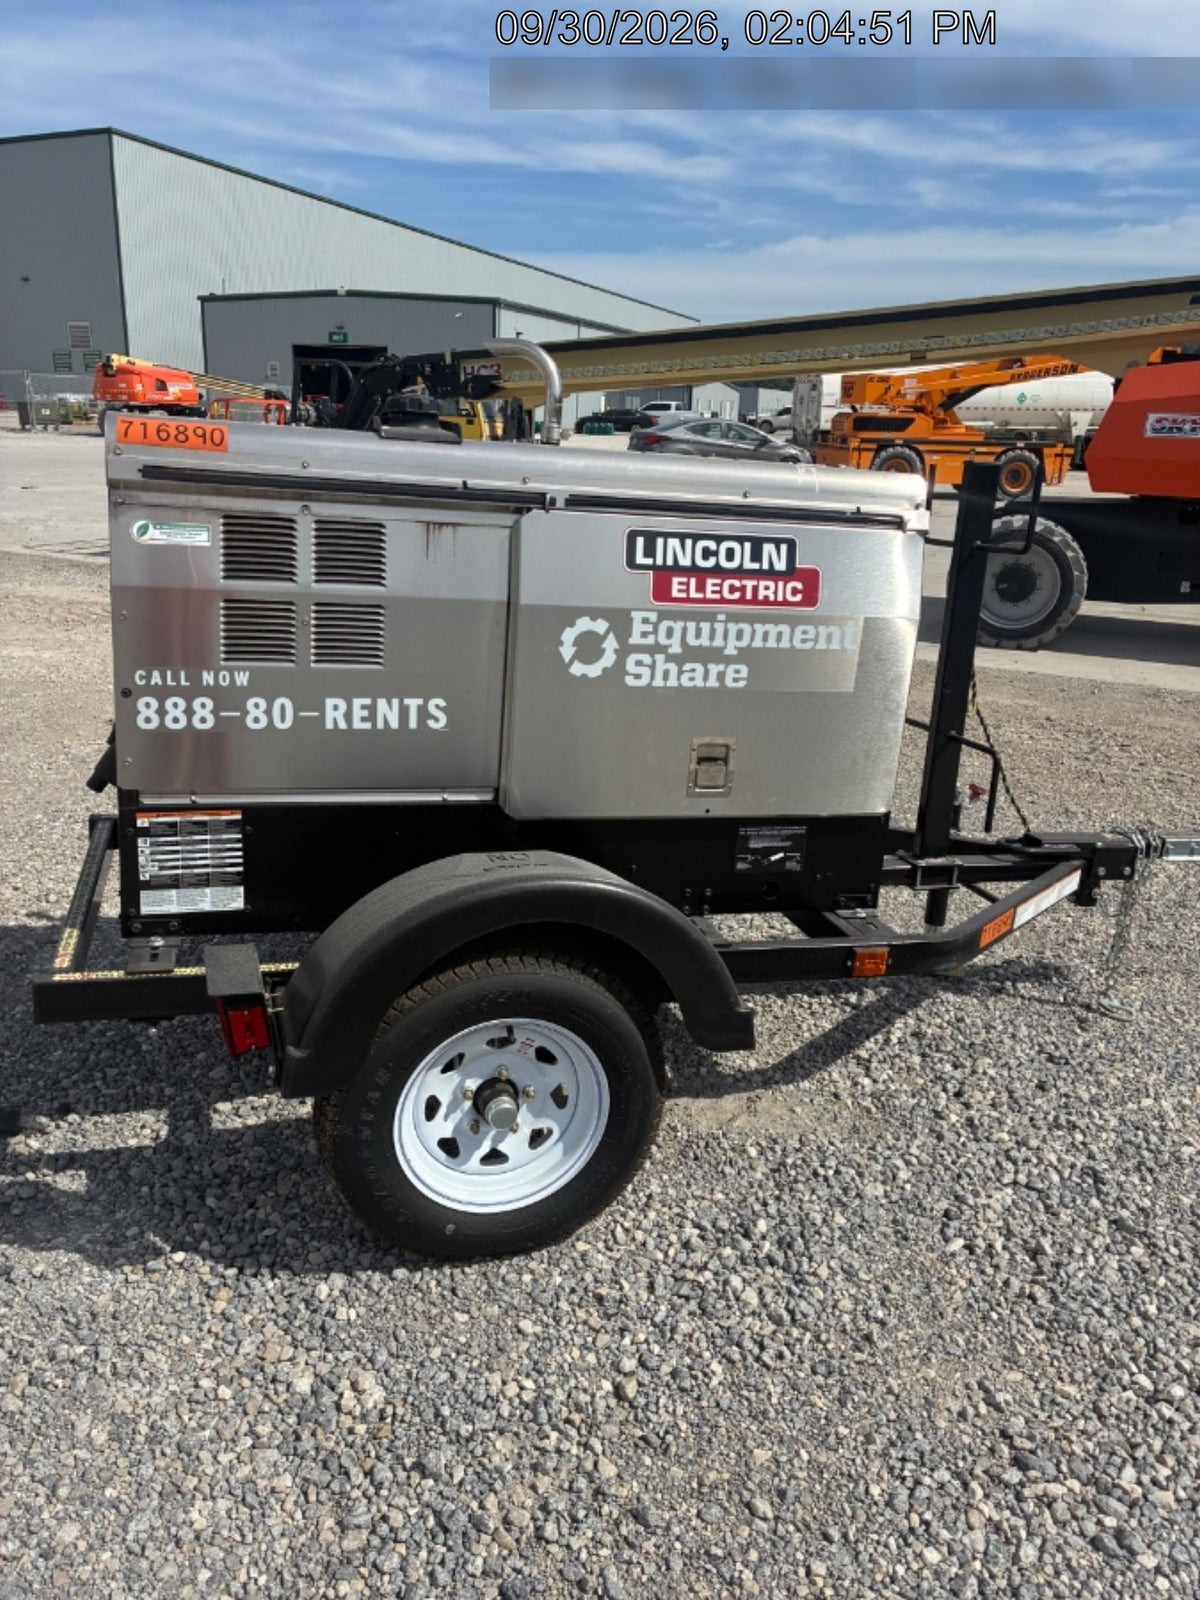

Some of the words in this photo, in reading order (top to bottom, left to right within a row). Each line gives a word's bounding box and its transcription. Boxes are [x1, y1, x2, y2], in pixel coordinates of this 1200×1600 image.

[120, 419, 225, 447] 716890
[635, 535, 788, 572] LINCOLN
[671, 576, 805, 602] ELECTRIC
[628, 610, 859, 655] Equipment
[134, 669, 191, 686] CALL
[202, 670, 250, 687] NOW
[624, 653, 750, 688] Share
[136, 696, 448, 730] 888-80-RENTS
